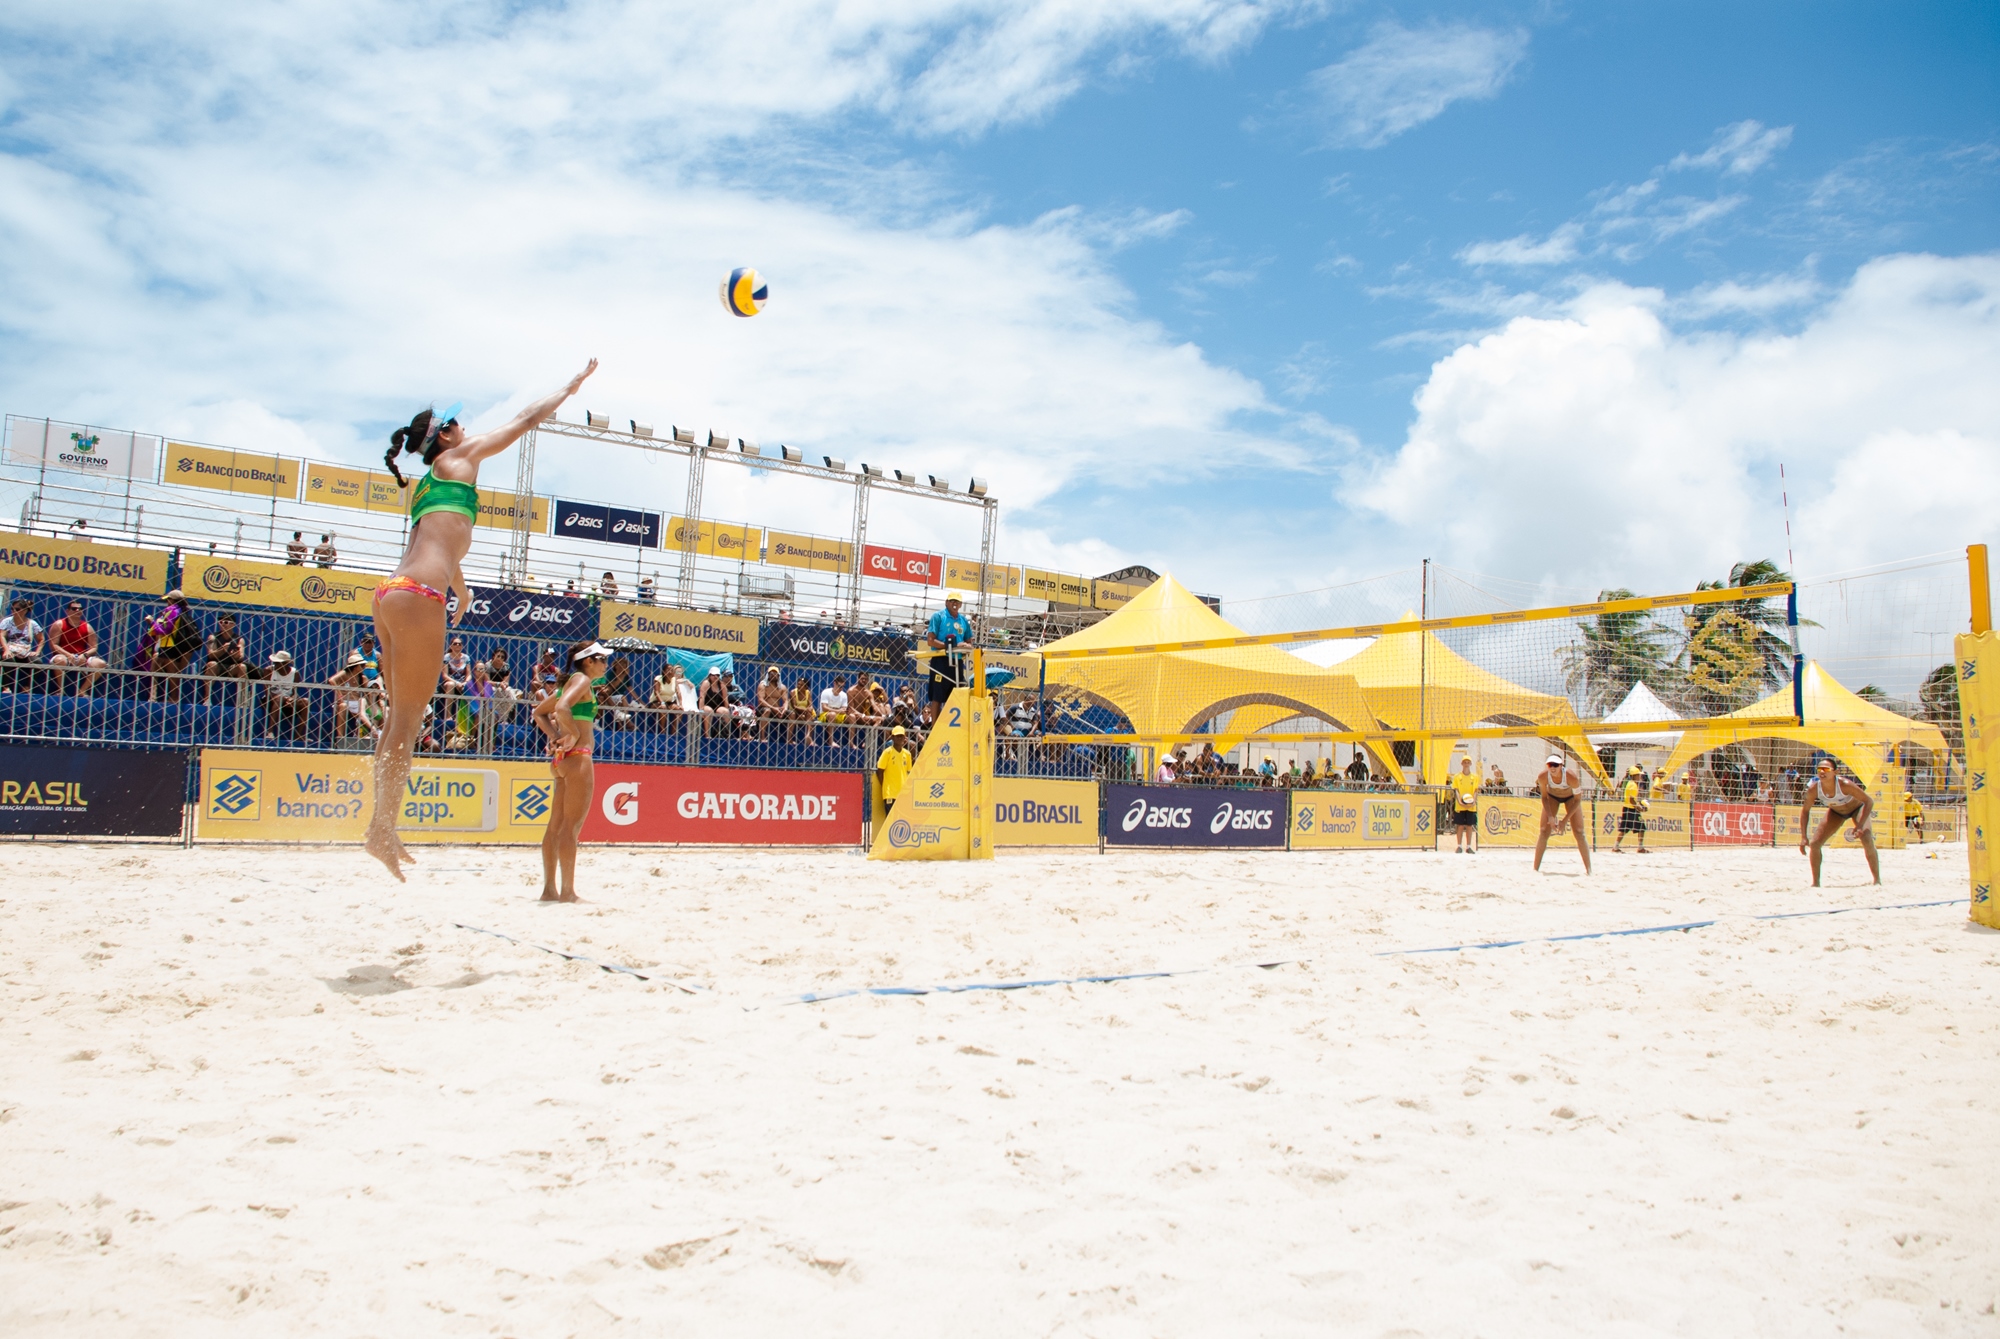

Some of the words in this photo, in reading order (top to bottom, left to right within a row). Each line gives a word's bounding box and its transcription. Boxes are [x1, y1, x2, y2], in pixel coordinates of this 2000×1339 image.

[60, 453, 108, 465] GOVERNO
[196, 462, 232, 476] BANCO
[234, 468, 249, 479] DO
[251, 469, 287, 484] BRASIL
[331, 486, 359, 497] banco?
[337, 479, 348, 487] Vai
[372, 484, 384, 492] Vai
[372, 492, 389, 501] app.
[494, 506, 506, 516] DO
[578, 516, 604, 529] asics
[625, 522, 650, 535] asics
[0, 548, 50, 568] ANCO
[54, 555, 80, 572] DO
[82, 556, 147, 580] BRASIL
[788, 546, 812, 558] BANCO
[813, 550, 823, 558] DO
[824, 551, 847, 563] BRASIL
[871, 554, 897, 572] GOL
[906, 560, 932, 576] GOL
[230, 578, 261, 592] OPEN
[326, 588, 356, 601] OPEN
[1029, 578, 1056, 588] CIMED
[1061, 584, 1088, 594] CIMED
[1110, 592, 1128, 602] BANCO
[446, 596, 492, 615] aics
[530, 605, 573, 624] asics
[637, 616, 682, 636] BANCO
[684, 624, 700, 638] DO
[702, 624, 745, 643] BRASIL
[790, 637, 828, 655] VÔLEI
[847, 645, 890, 662] BRASIL
[949, 707, 961, 727] 2
[295, 772, 330, 794] Vai
[336, 778, 363, 795] ao
[406, 775, 440, 797] Vai
[447, 780, 475, 798] no
[1881, 773, 1889, 783] 5
[2, 781, 88, 806] RASIL
[277, 797, 362, 818] banco?
[404, 800, 454, 823] app.
[602, 782, 639, 826] G
[677, 792, 836, 821] GATORADE
[995, 803, 1020, 823] DO
[1023, 800, 1082, 824] BRASIL
[1329, 805, 1343, 818] Vai
[1346, 808, 1356, 818] ao
[1372, 805, 1387, 818] Vai
[1389, 808, 1401, 818] no
[1145, 807, 1192, 828] asics
[1232, 809, 1273, 830] asics
[1322, 821, 1356, 833] banco?
[1372, 821, 1392, 835] app.
[1501, 818, 1520, 830] OPEN
[1646, 818, 1656, 831] DO
[1658, 816, 1683, 832] BRASIL
[1703, 812, 1730, 836] GOL
[1739, 812, 1764, 835] GOL
[912, 831, 940, 843] OPEN
